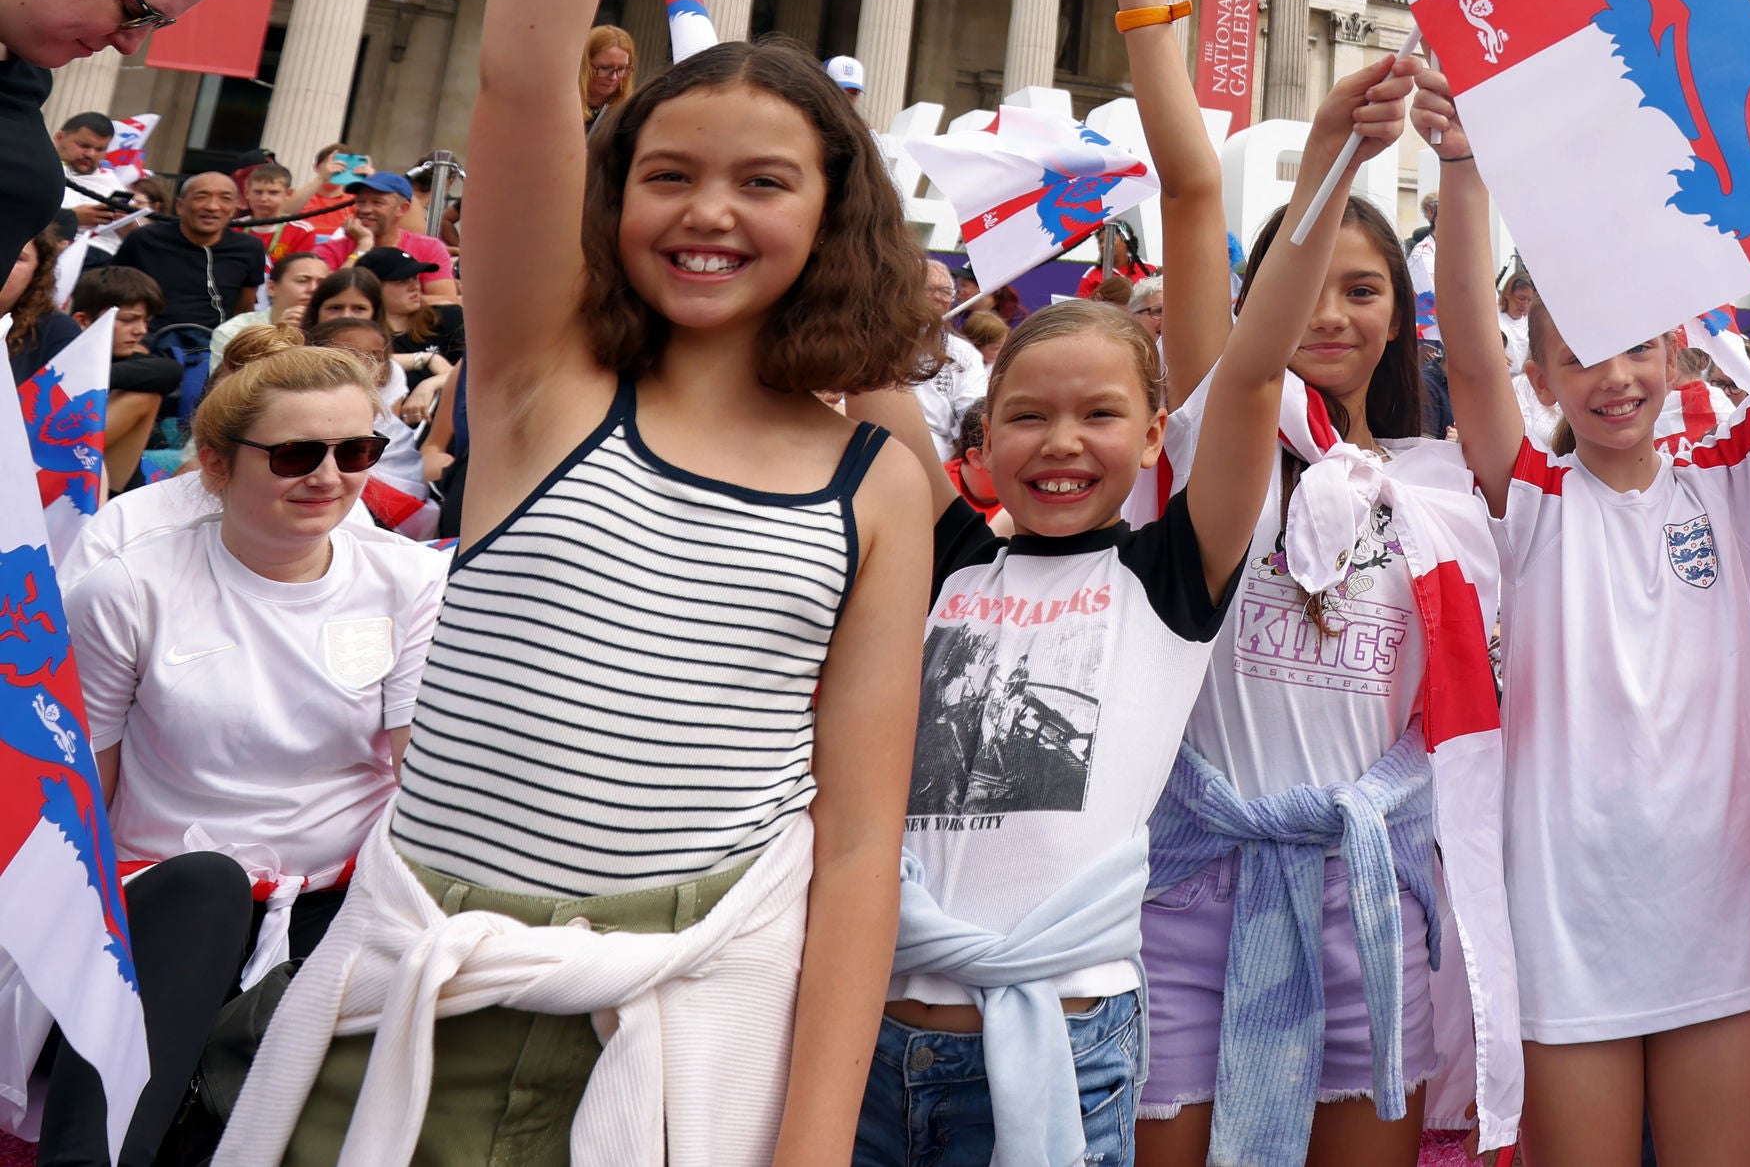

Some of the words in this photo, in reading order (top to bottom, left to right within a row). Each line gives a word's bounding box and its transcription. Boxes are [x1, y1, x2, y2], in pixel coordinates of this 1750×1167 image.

[1204, 41, 1214, 63] THE
[1247, 581, 1408, 621] SYNEY
[1236, 598, 1406, 675] KINGS
[1233, 659, 1390, 693] BASKETBALL
[904, 817, 931, 832] NEW
[934, 816, 966, 832] YORK
[969, 815, 1005, 831] CITY
